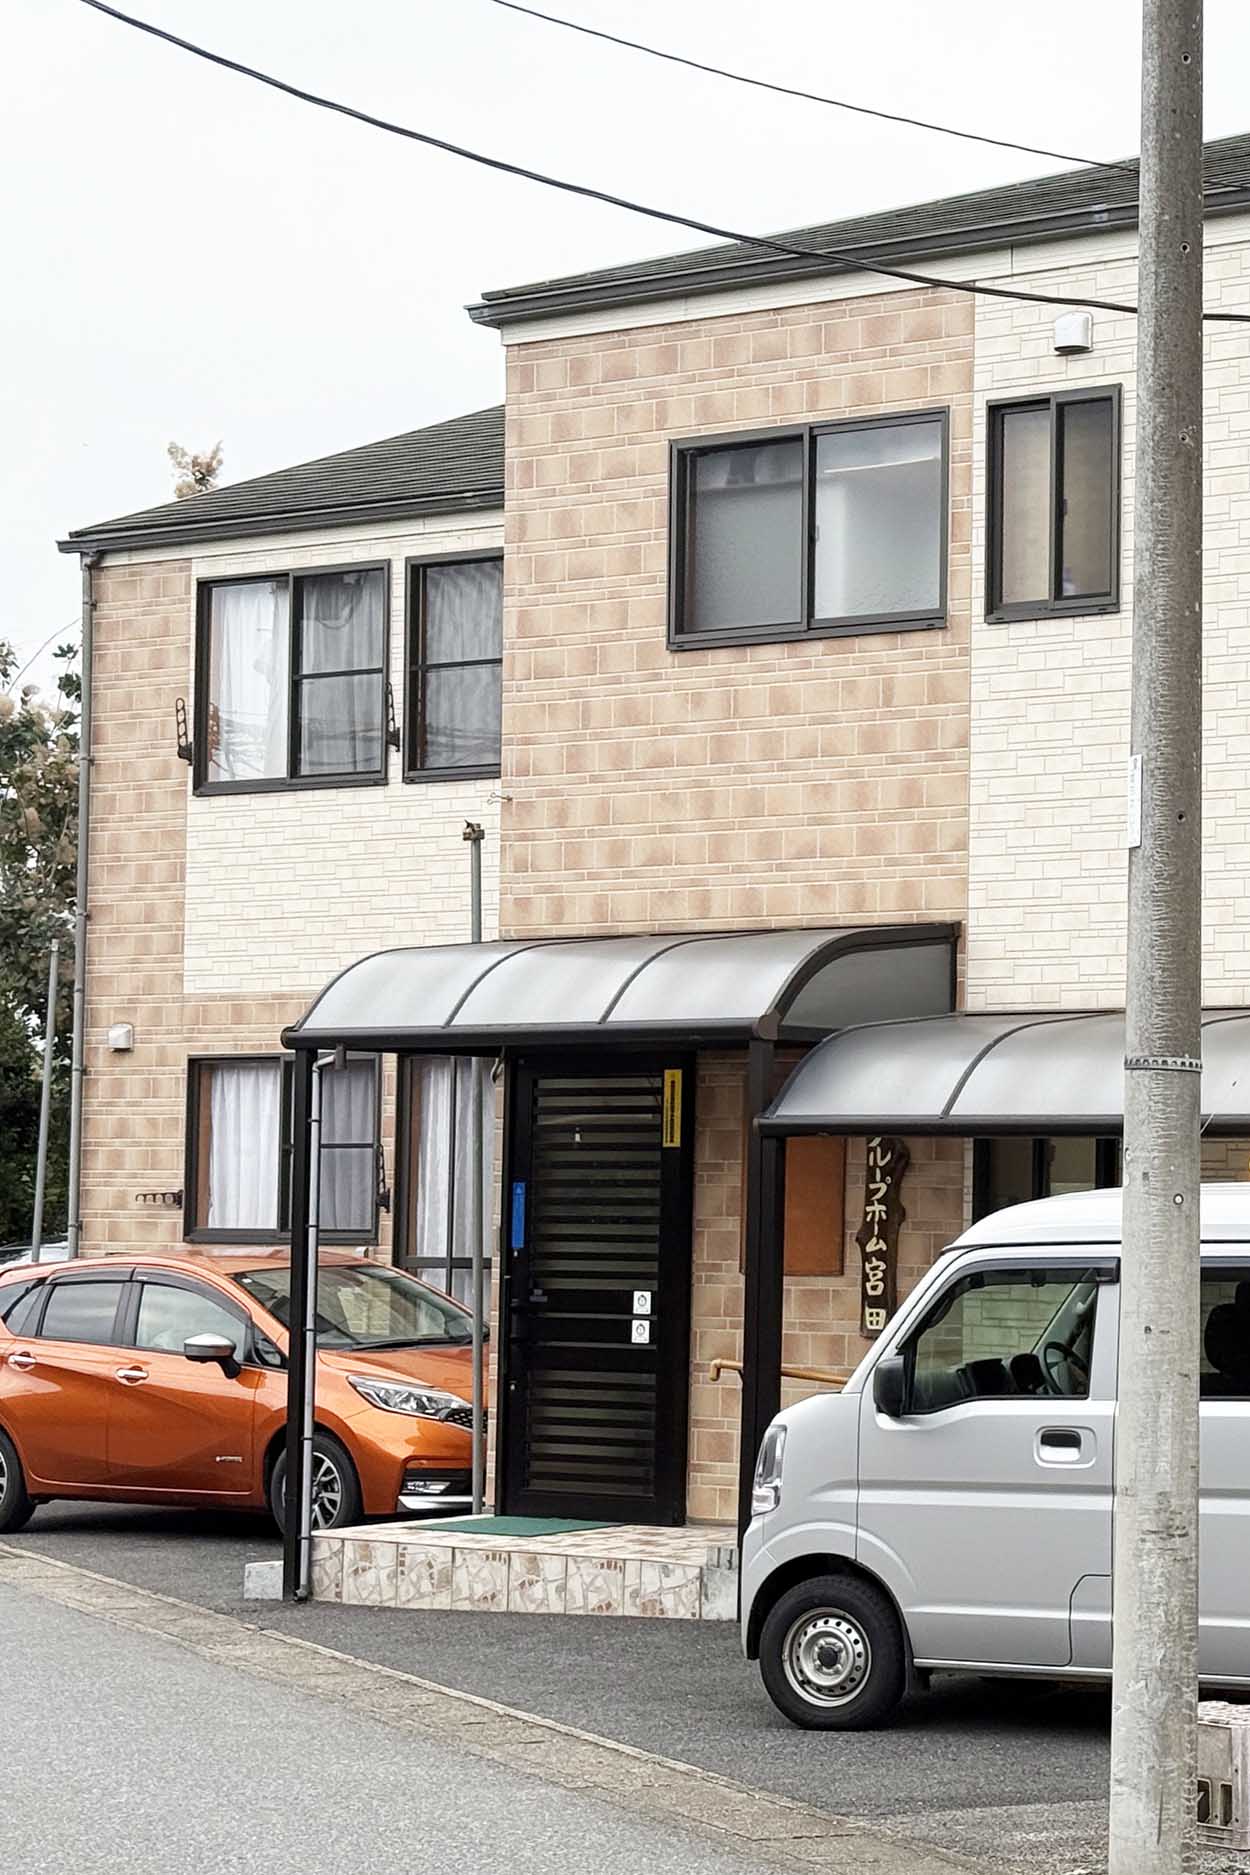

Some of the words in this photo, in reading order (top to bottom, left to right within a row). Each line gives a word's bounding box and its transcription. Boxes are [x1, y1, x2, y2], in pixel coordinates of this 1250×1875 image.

[865, 1137, 891, 1330] ループホーム宮田
